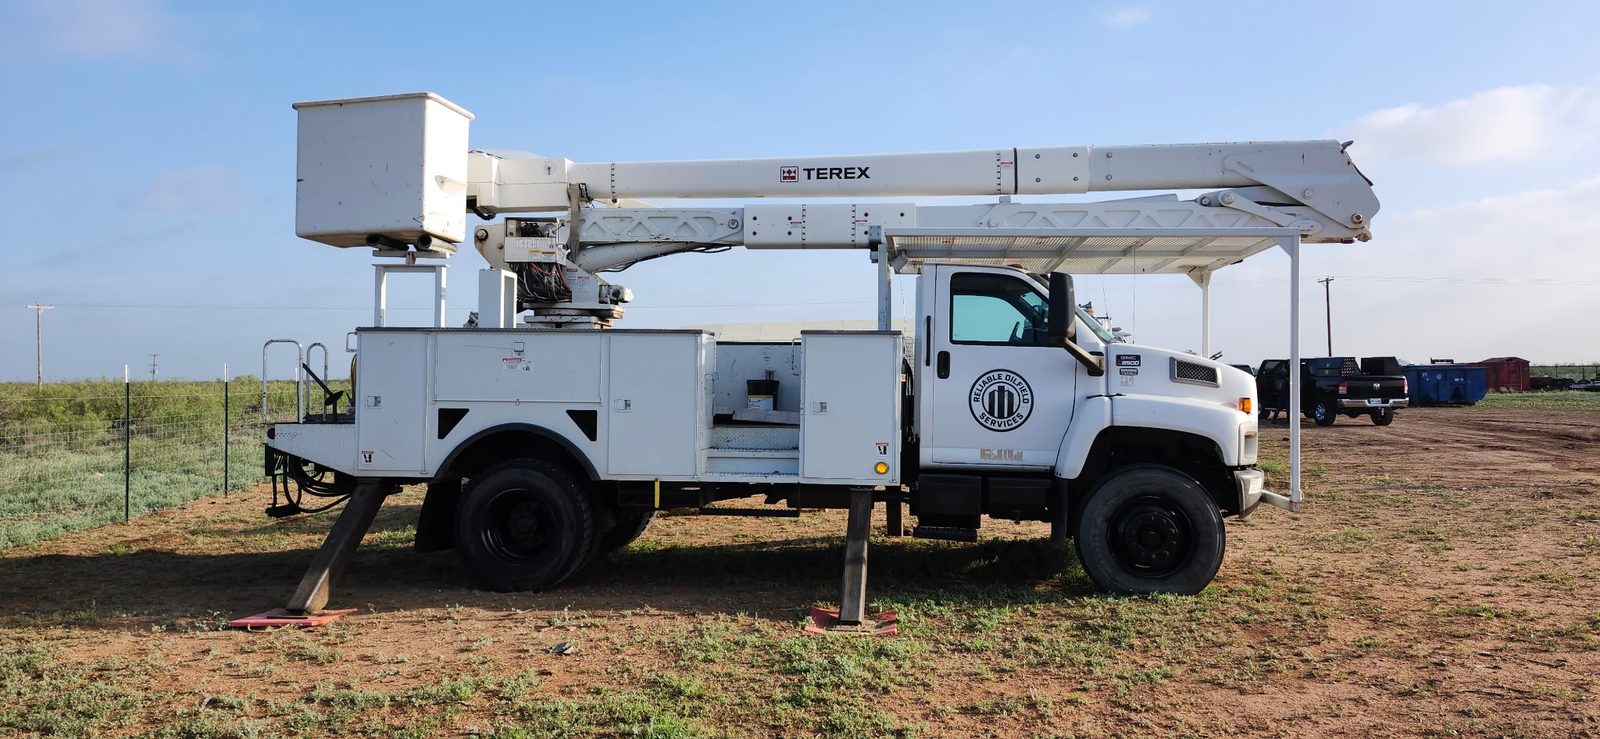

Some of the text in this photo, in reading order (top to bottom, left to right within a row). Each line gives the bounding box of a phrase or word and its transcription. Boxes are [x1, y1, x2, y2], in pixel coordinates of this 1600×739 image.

[803, 167, 870, 180] TEREX
[973, 373, 1002, 403] RELIABLE
[979, 412, 1024, 428] SERVICES
